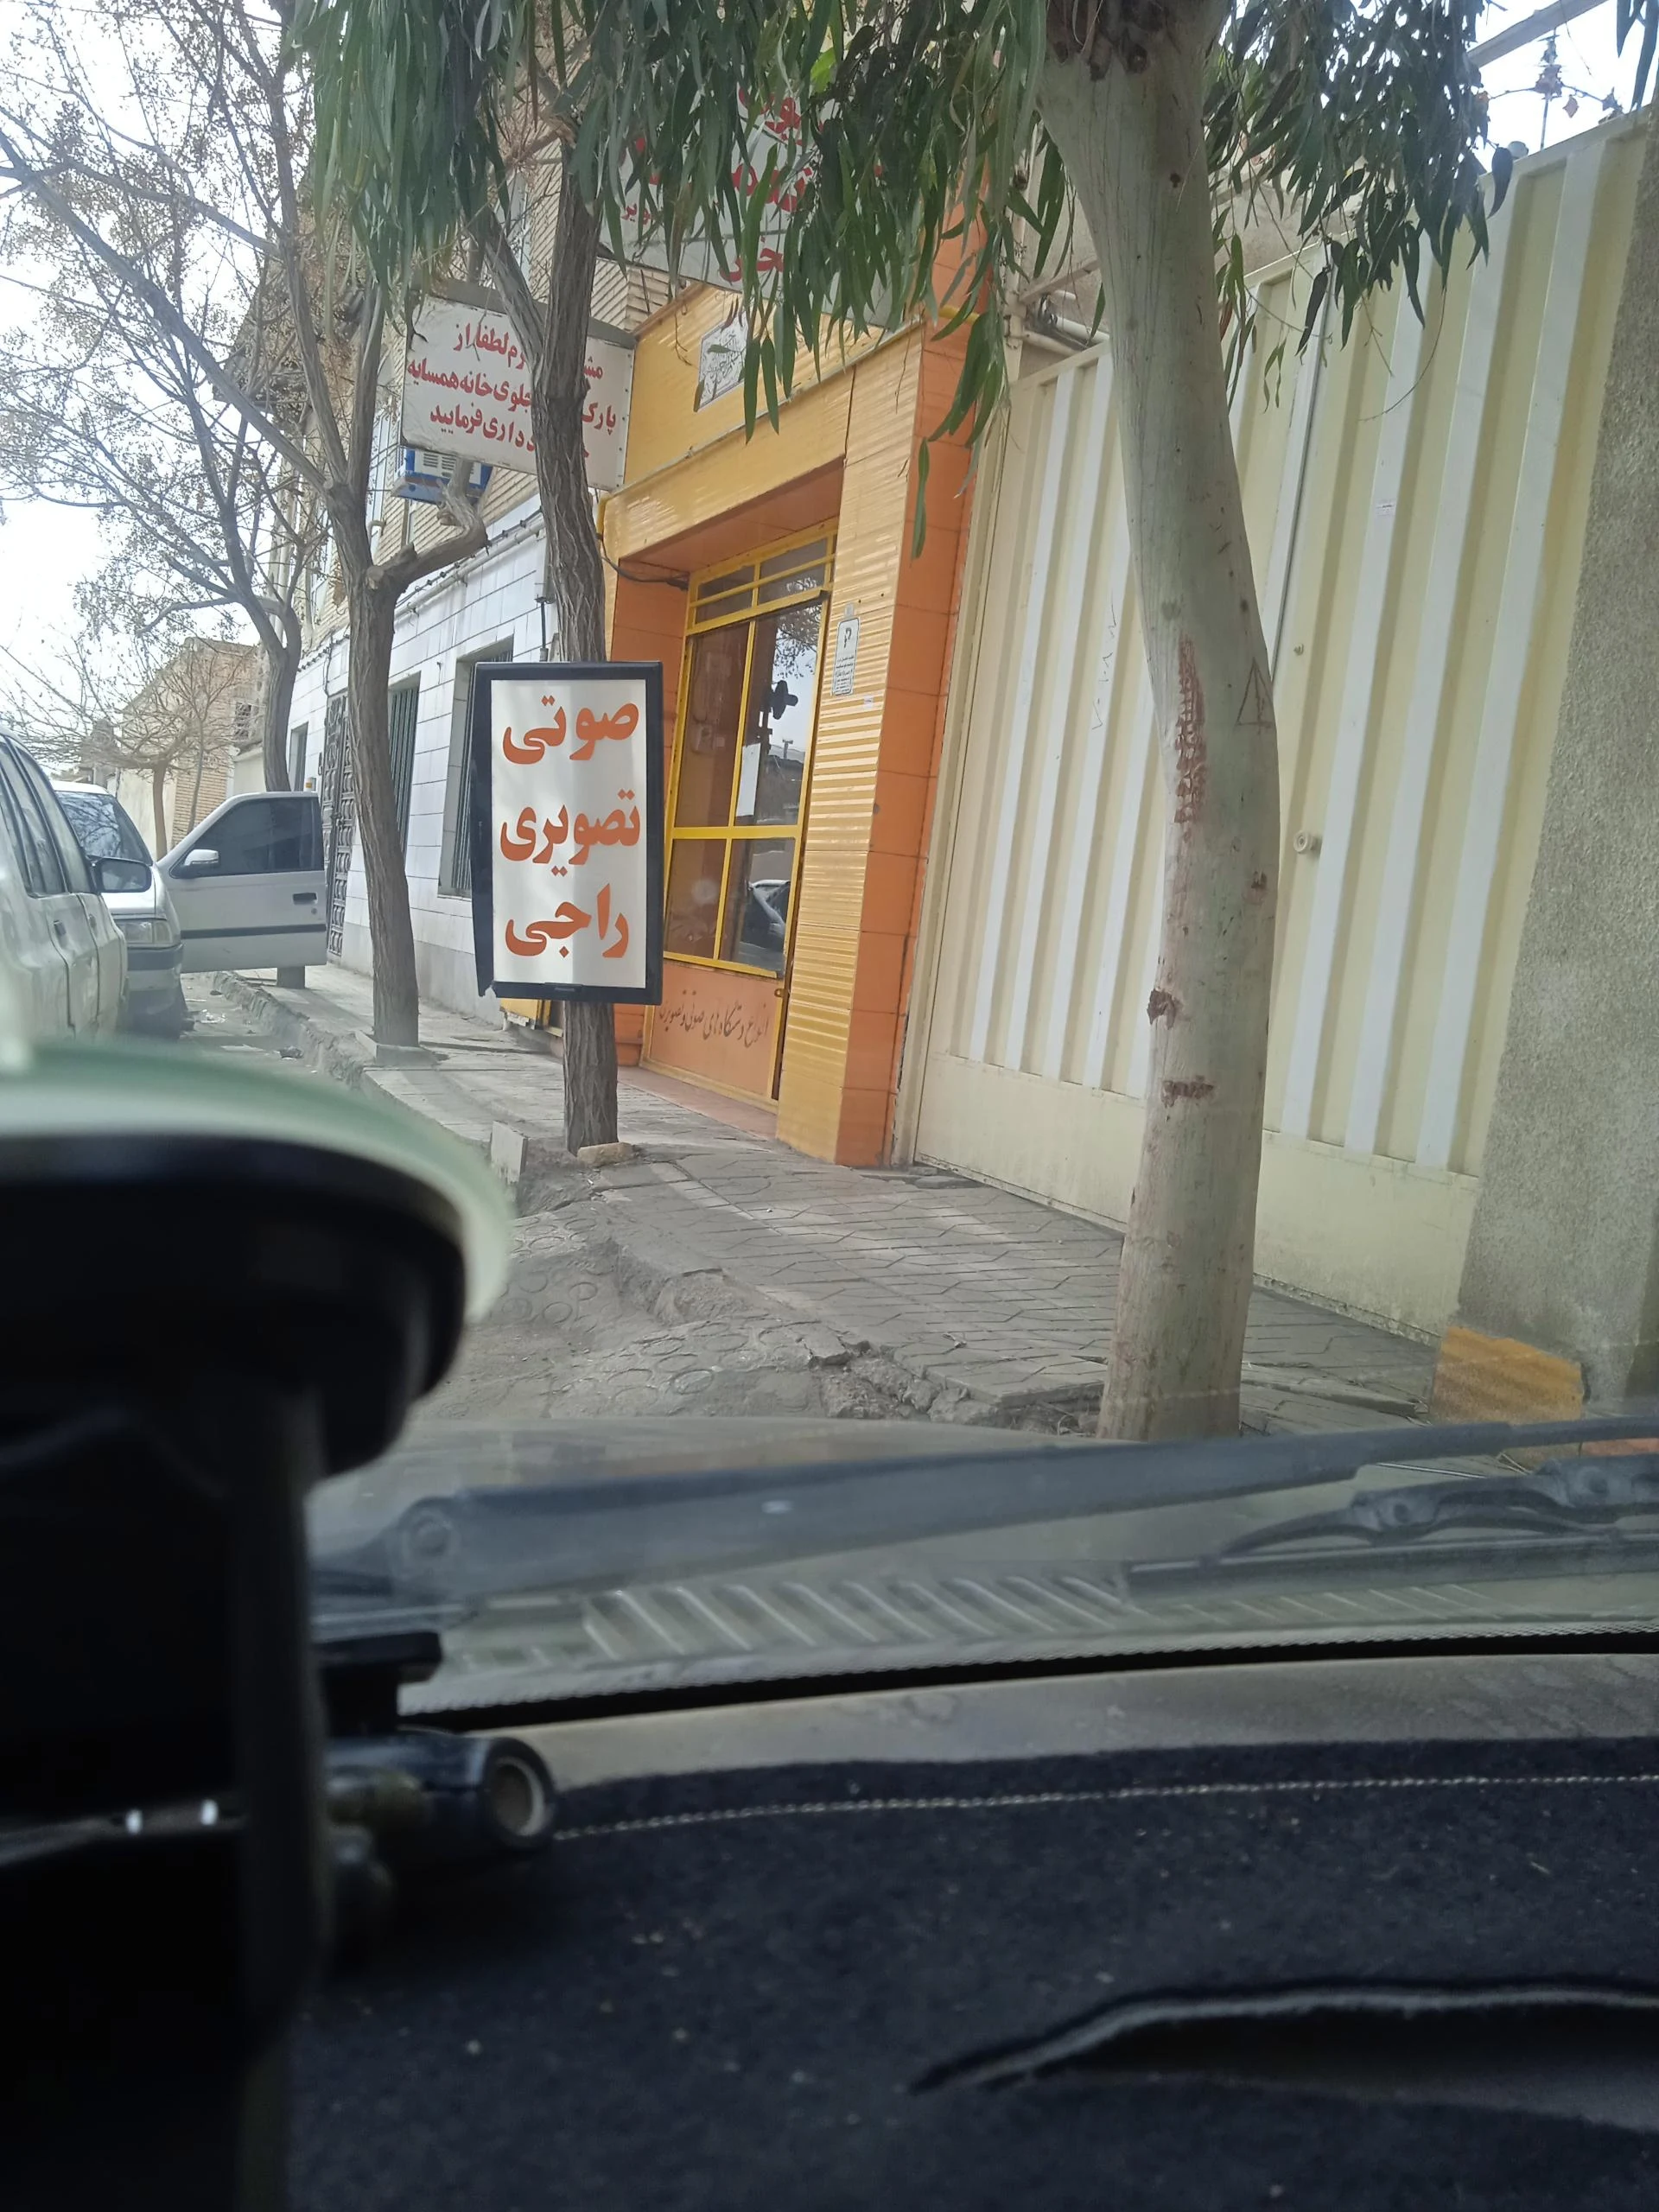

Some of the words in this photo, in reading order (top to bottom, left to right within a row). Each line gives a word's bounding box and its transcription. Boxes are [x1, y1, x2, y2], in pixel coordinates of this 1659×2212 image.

[453, 323, 471, 352] از
[475, 323, 509, 355] لطفا
[407, 357, 460, 390] همسایه
[460, 371, 493, 397] خانه
[429, 402, 483, 434] فرمایید
[502, 695, 639, 766] صوتی
[499, 788, 641, 878] تصویری
[505, 882, 630, 959] راجی
